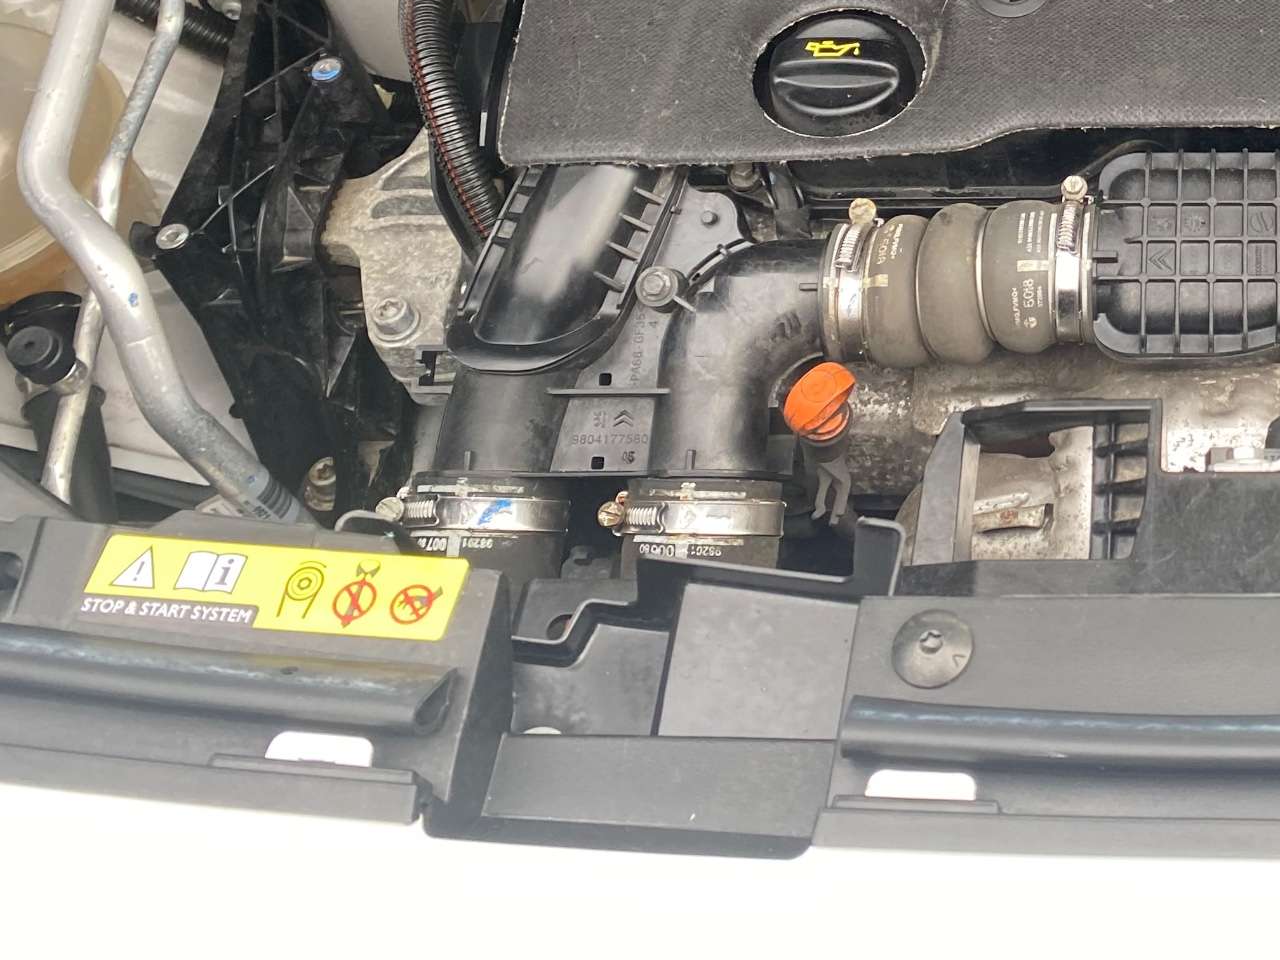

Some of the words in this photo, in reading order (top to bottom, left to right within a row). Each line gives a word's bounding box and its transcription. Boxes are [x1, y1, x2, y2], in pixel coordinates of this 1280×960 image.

[81, 596, 126, 614] STOP
[124, 601, 138, 616] &
[138, 601, 187, 620] START
[190, 604, 253, 624] SYSTEM
